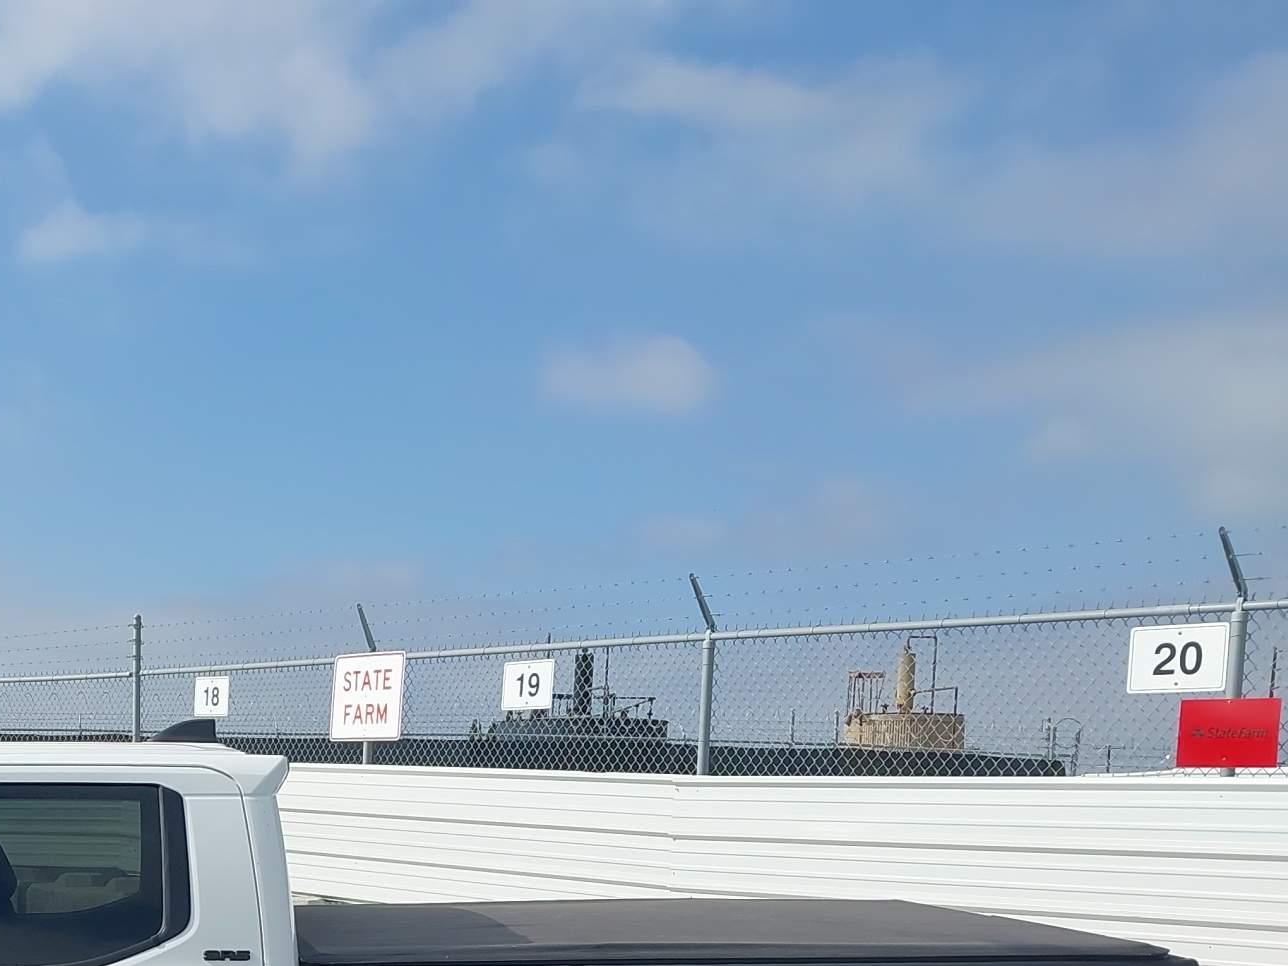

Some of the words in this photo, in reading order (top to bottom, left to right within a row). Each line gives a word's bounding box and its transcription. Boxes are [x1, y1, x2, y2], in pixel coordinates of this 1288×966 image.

[1152, 641, 1203, 676] 20
[343, 669, 393, 692] STATE
[516, 672, 540, 698] 19
[204, 686, 220, 707] 18
[343, 703, 388, 725] FARM
